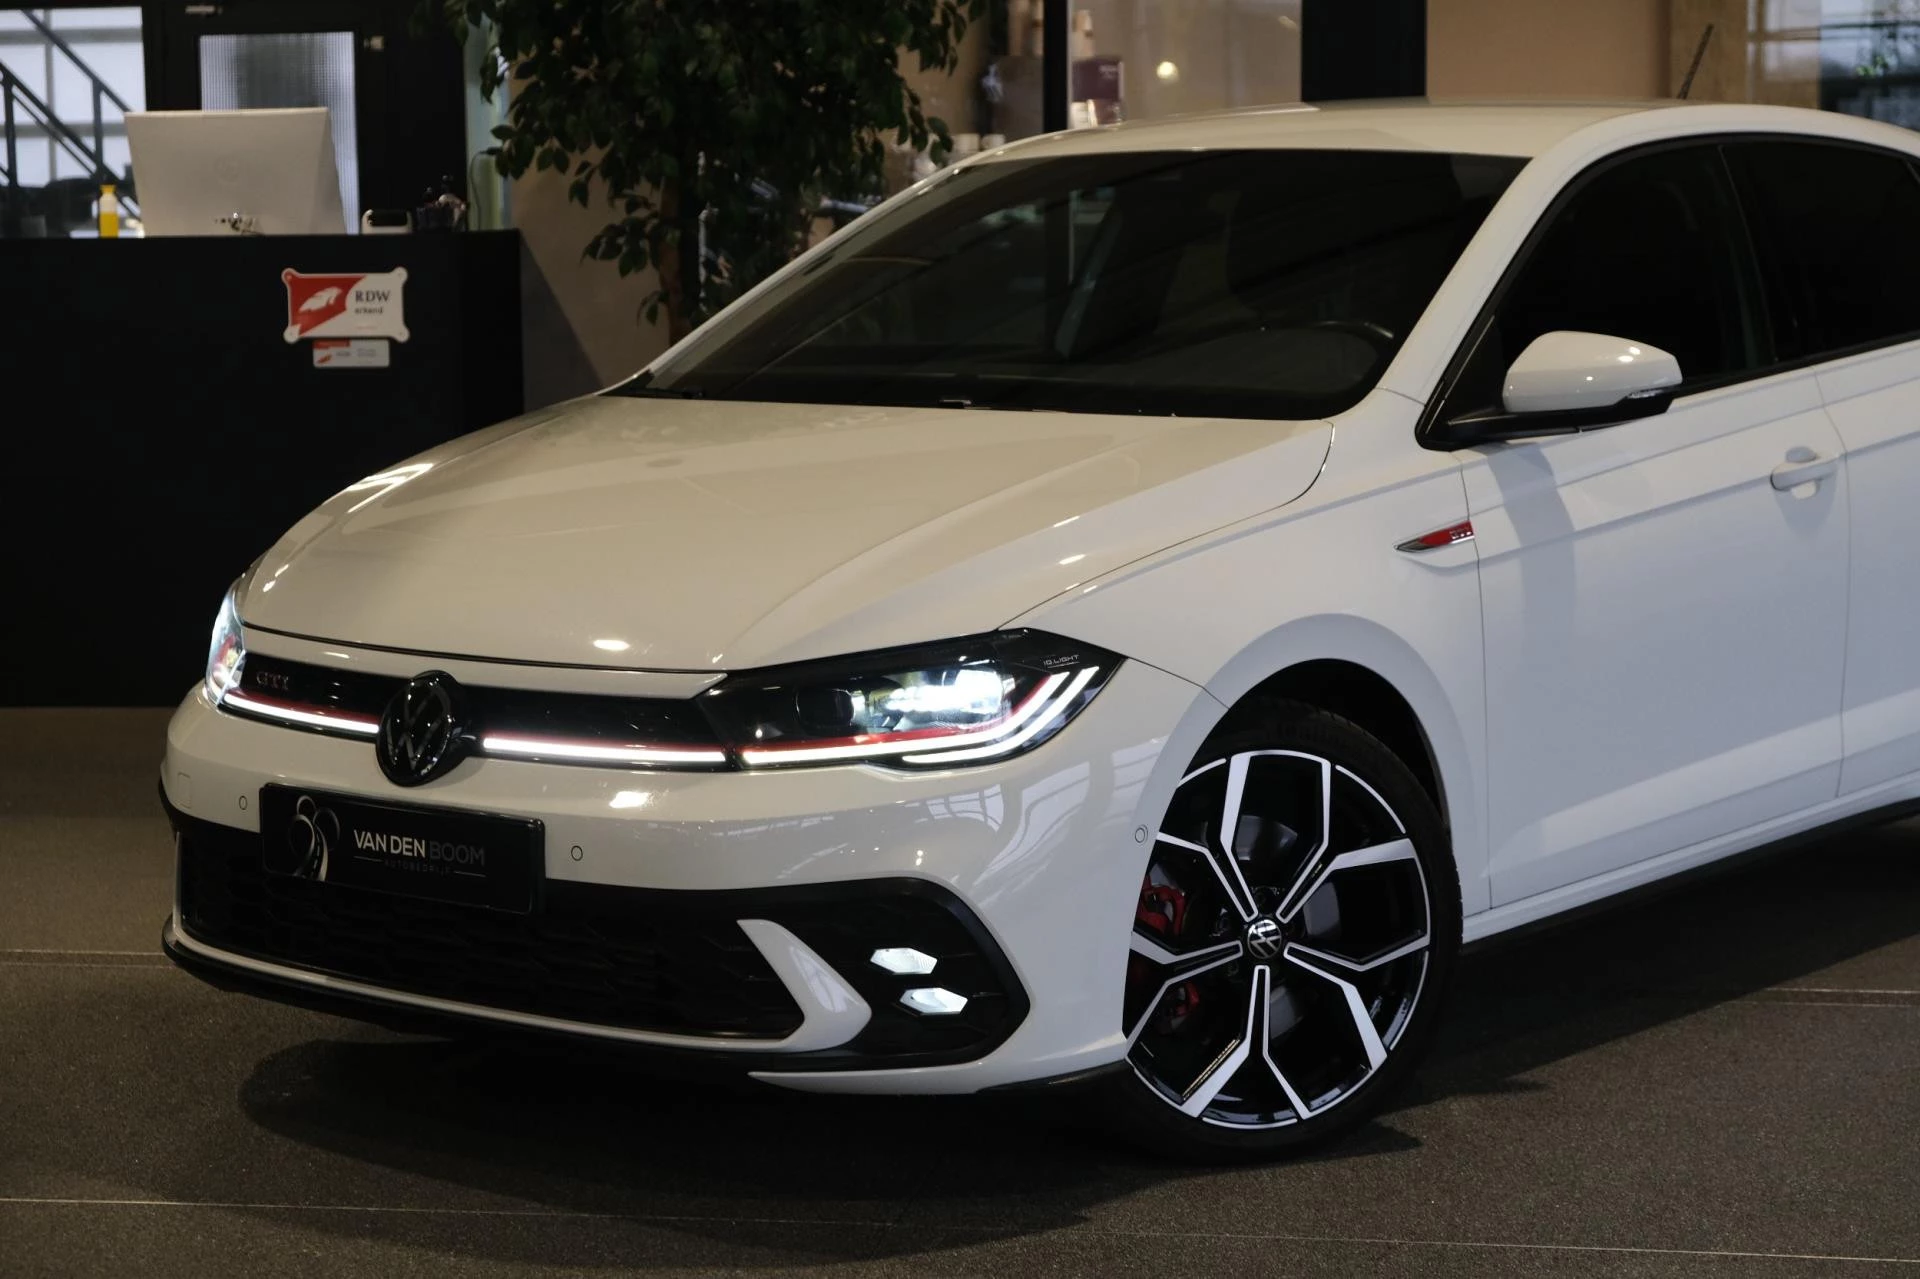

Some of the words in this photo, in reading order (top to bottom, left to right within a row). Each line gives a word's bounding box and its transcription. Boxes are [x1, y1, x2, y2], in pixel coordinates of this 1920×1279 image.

[355, 290, 391, 303] RDW
[353, 829, 387, 852] VAN
[390, 834, 426, 858] DEN
[429, 840, 485, 867] BOOM
